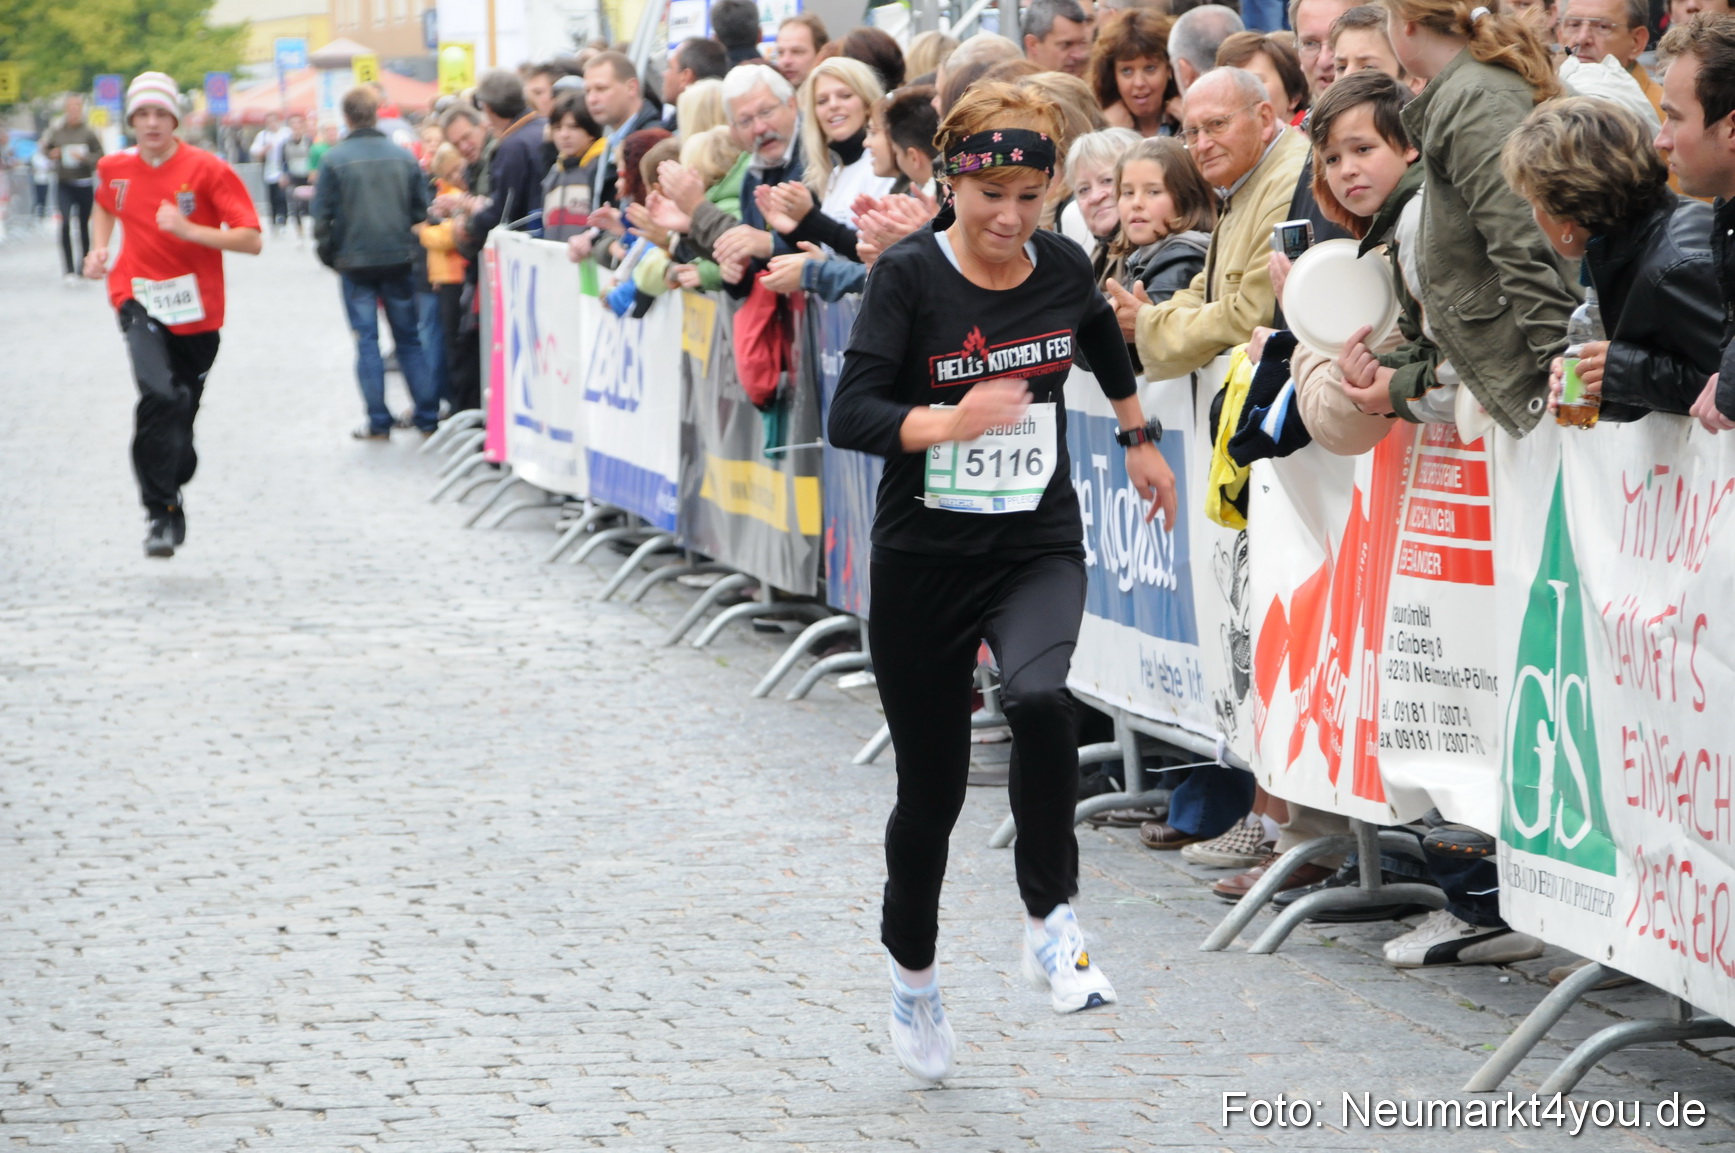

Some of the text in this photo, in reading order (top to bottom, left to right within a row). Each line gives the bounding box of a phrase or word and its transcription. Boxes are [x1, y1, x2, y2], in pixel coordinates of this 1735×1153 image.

[110, 179, 131, 211] 7
[153, 289, 193, 309] 5148
[988, 342, 1043, 372] KITCHEN
[1046, 335, 1072, 360] FEST
[965, 447, 1044, 478] 5116
[1435, 636, 1443, 658] 8
[1394, 699, 1428, 724] 09181
[1379, 730, 1393, 749] ax
[1394, 728, 1433, 751] 09181
